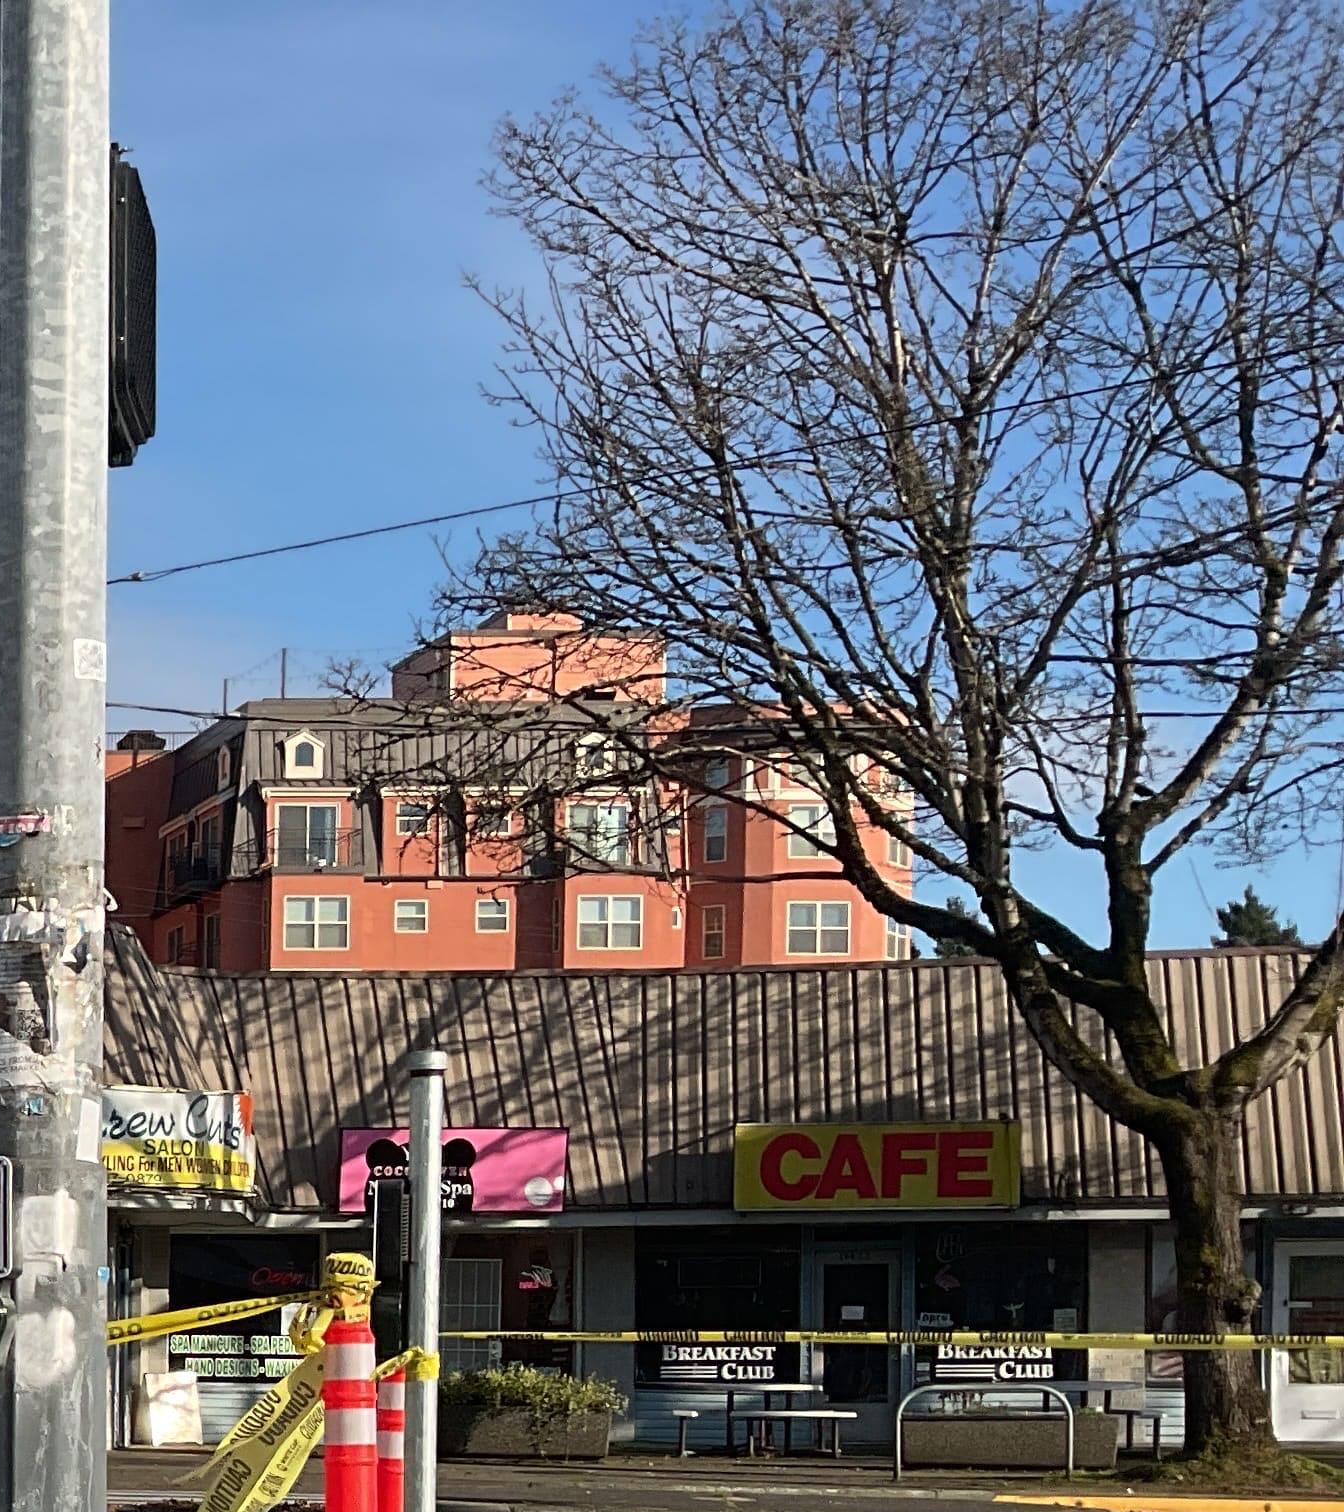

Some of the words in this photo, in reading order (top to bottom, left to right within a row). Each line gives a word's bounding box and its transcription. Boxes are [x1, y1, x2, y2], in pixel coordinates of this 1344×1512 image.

[10, 1064, 41, 1073] MARKE
[103, 1109, 175, 1139] rew
[186, 1094, 241, 1149] Cuts
[143, 1139, 205, 1156] SALON
[158, 1156, 182, 1173] MEN
[760, 1131, 994, 1199] CAFE
[440, 1180, 472, 1199] Spa
[170, 1335, 189, 1354] SPA
[191, 1335, 244, 1354] MANICURE
[251, 1335, 270, 1354] SPA
[662, 1345, 776, 1361] BREAKFAST
[937, 1344, 1053, 1360] BREAKFAST
[185, 1358, 214, 1377] HAND
[215, 1358, 260, 1377] DESIGNS
[720, 1363, 775, 1379] CLUB
[999, 1361, 1054, 1379] CLUB
